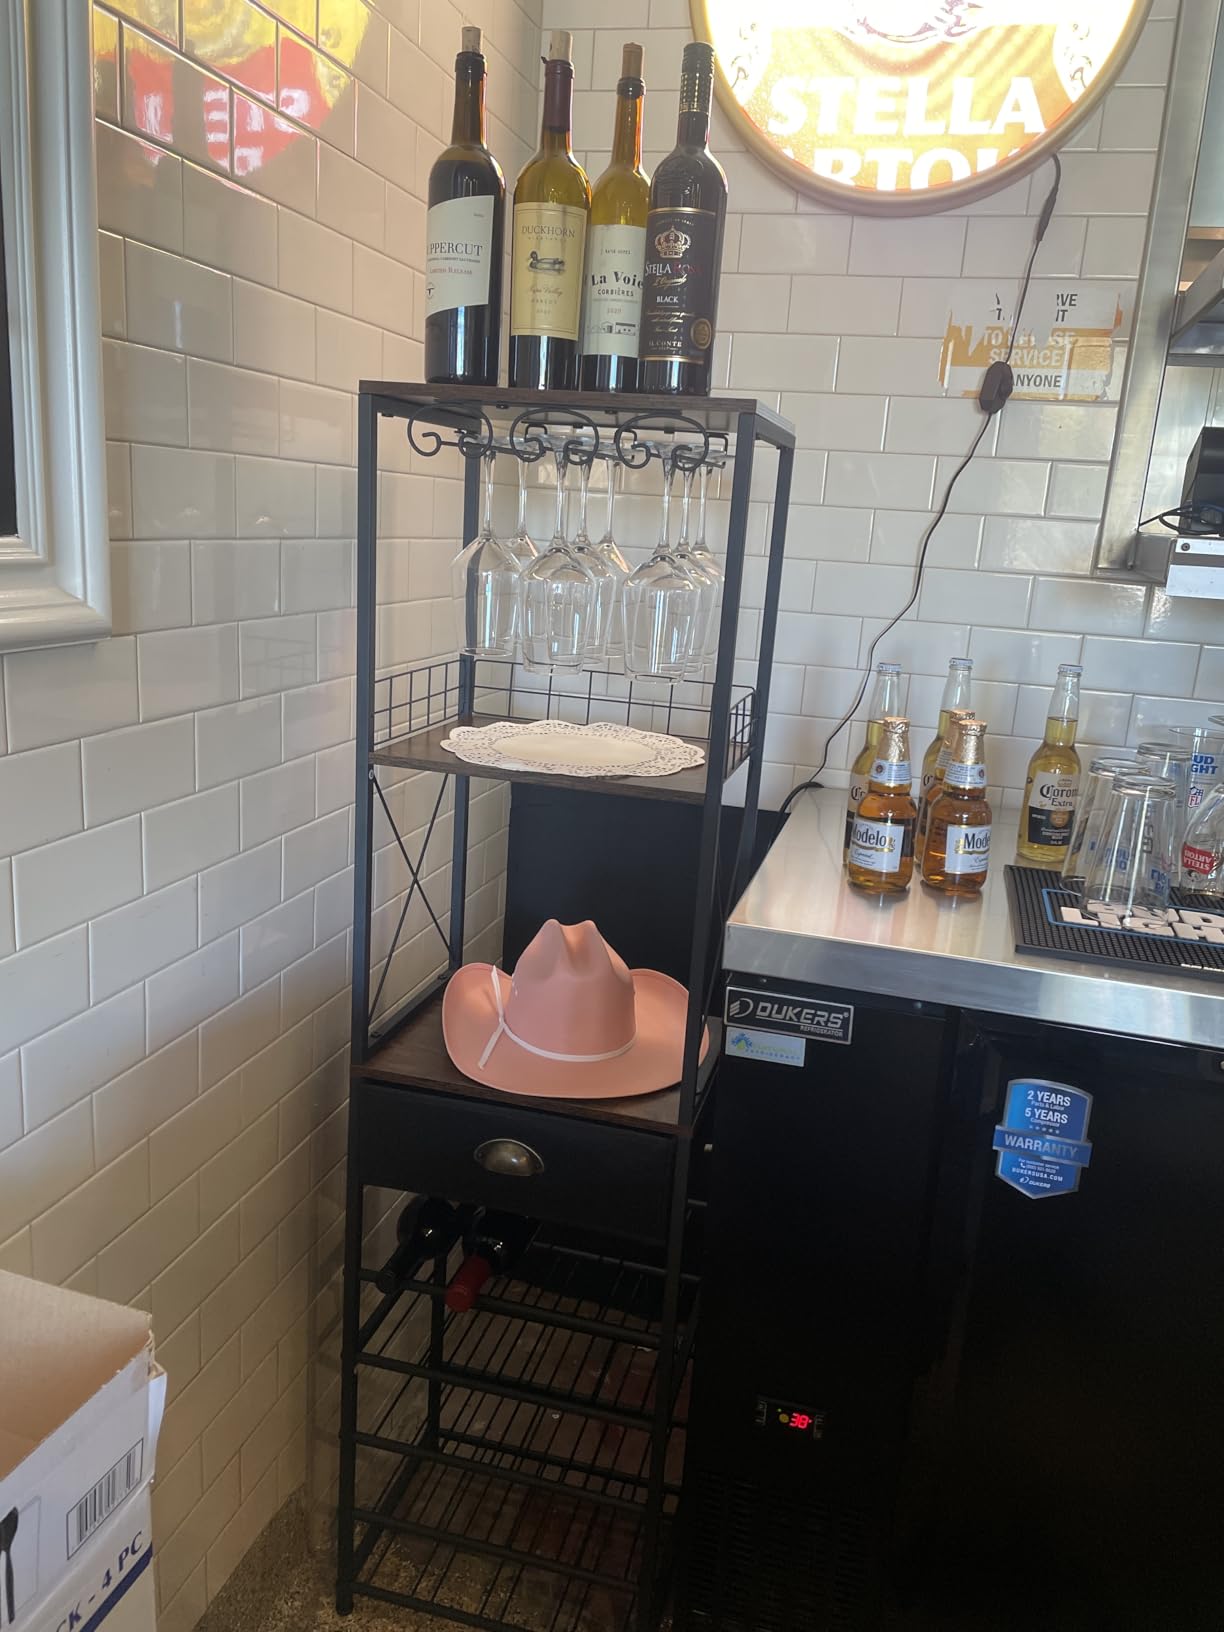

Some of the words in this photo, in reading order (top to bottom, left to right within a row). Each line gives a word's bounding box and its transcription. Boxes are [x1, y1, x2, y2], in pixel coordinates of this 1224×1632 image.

[767, 76, 1046, 136] STELLA
[781, 147, 1023, 191] RTO
[522, 225, 576, 238] DUCKHORN
[426, 242, 483, 257] PPERCUT
[645, 262, 672, 276] STELLA
[591, 274, 607, 287] La
[656, 295, 679, 303] BLACK
[1012, 374, 1063, 388] NYONE
[1192, 754, 1215, 765] UD
[756, 1001, 844, 1029] DUKERS
[1027, 1090, 1035, 1101] 2
[1037, 1091, 1072, 1107] YEARS
[1024, 1107, 1032, 1118] 5
[1034, 1108, 1069, 1124] YEARS
[1004, 1133, 1078, 1159] WARRANTY
[102, 1567, 112, 1589] 4
[117, 1530, 143, 1572] PC
